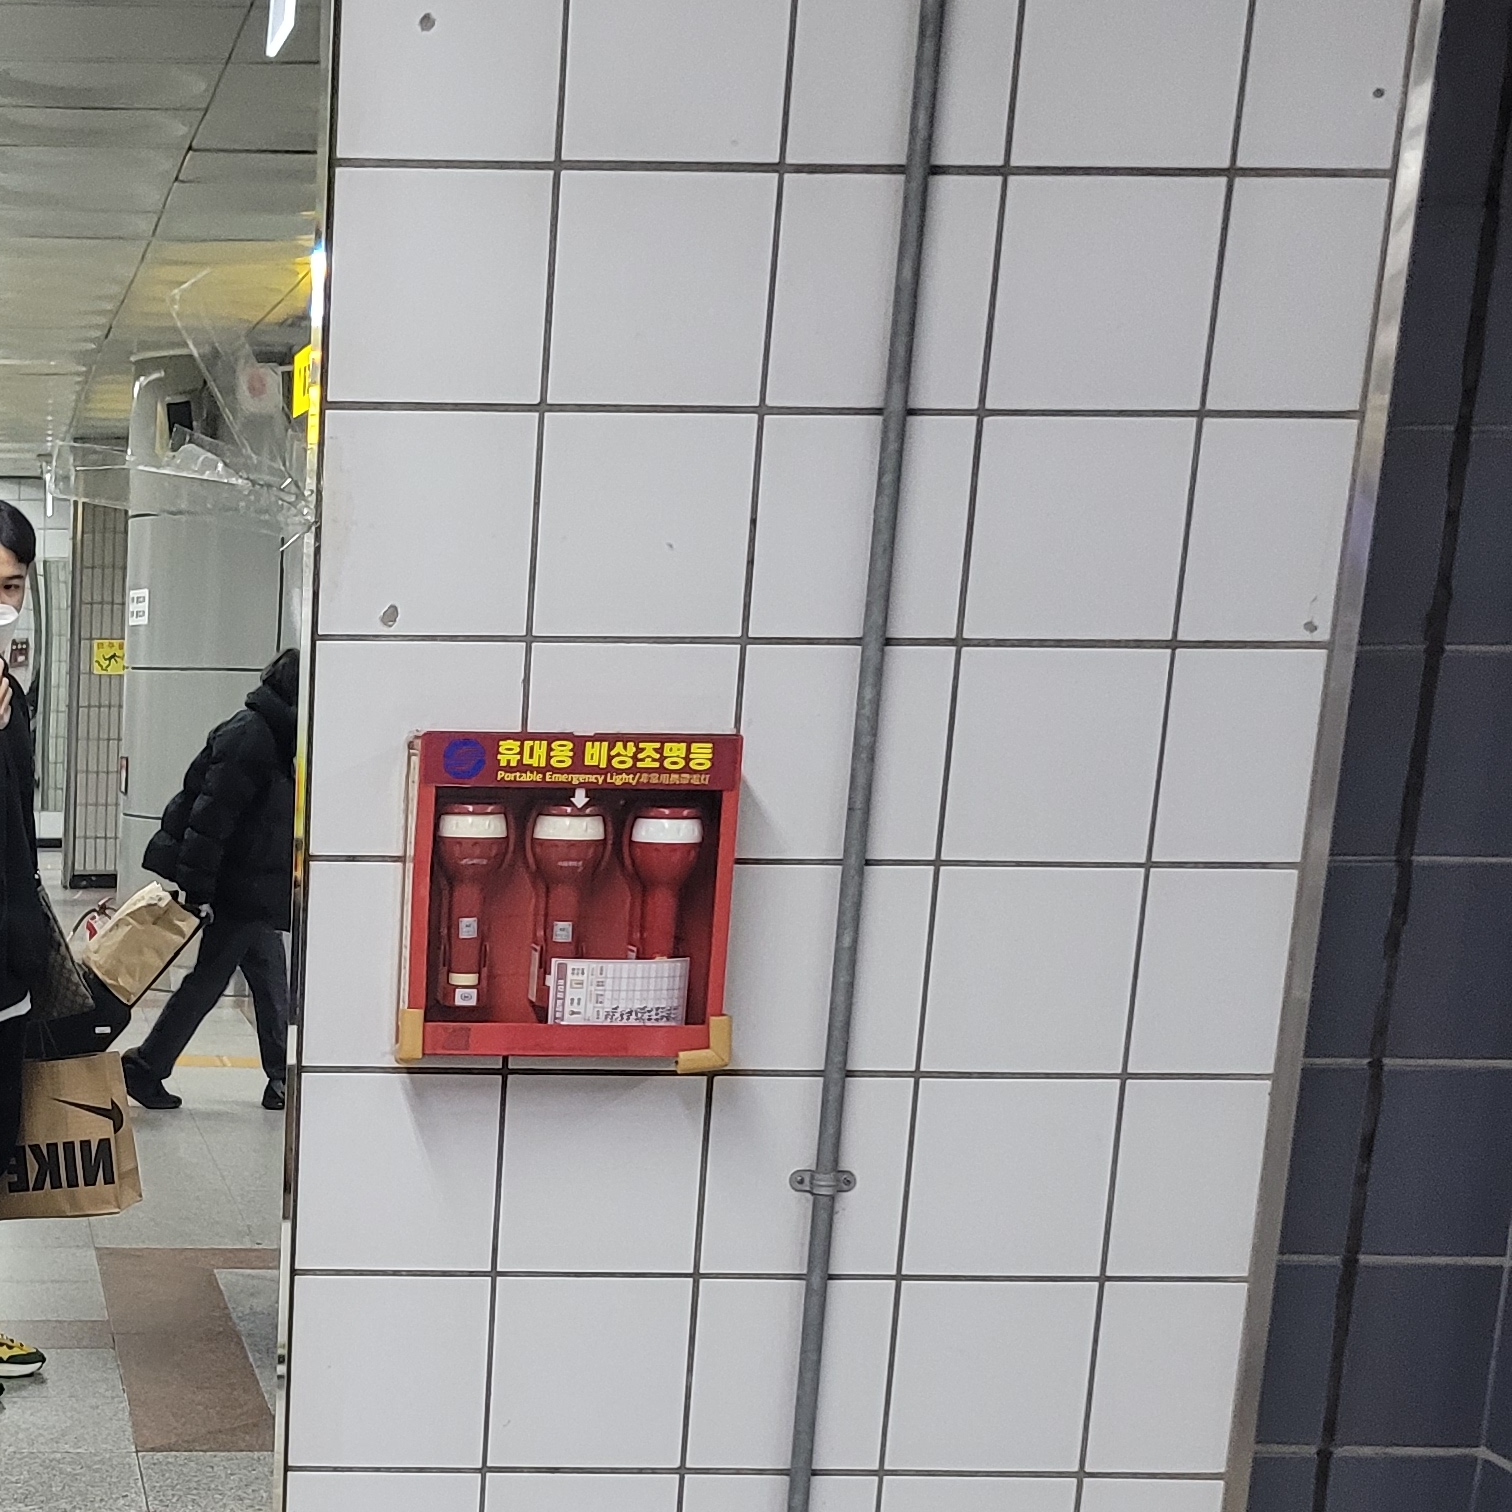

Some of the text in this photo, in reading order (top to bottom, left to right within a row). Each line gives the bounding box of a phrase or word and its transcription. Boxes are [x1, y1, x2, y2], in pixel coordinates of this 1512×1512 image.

[497, 739, 714, 770] 휴대용 비상조명등
[497, 770, 543, 783] Portable
[545, 772, 604, 785] Emergency
